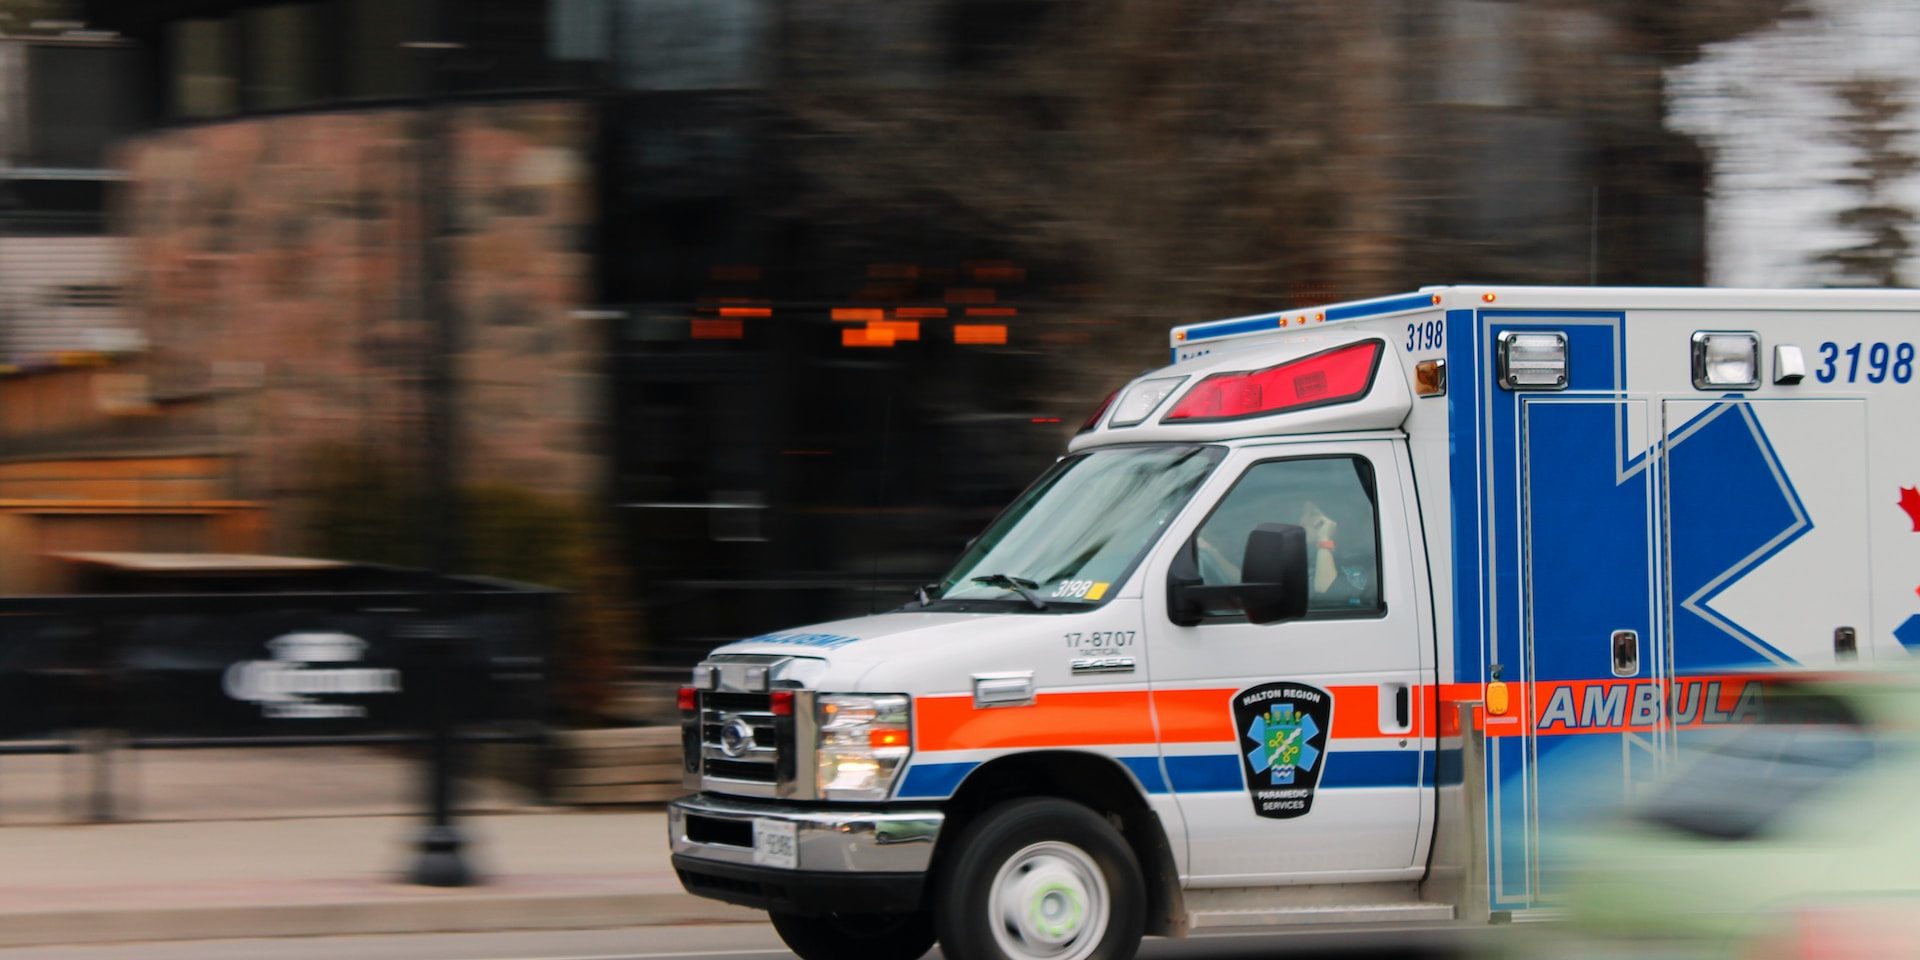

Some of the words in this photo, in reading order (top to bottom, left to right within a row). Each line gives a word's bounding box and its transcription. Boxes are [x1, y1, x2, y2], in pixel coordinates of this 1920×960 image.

[1405, 319, 1443, 352] 3198
[1815, 341, 1915, 384] 3198
[1051, 580, 1094, 598] 3198
[1064, 631, 1136, 648] 17-8707
[1243, 689, 1282, 706] HALTON
[1283, 688, 1321, 704] REGION
[1537, 681, 1768, 729] AMBULA
[1257, 789, 1309, 800] PARAMEDIC
[1262, 801, 1305, 811] SERVICES
